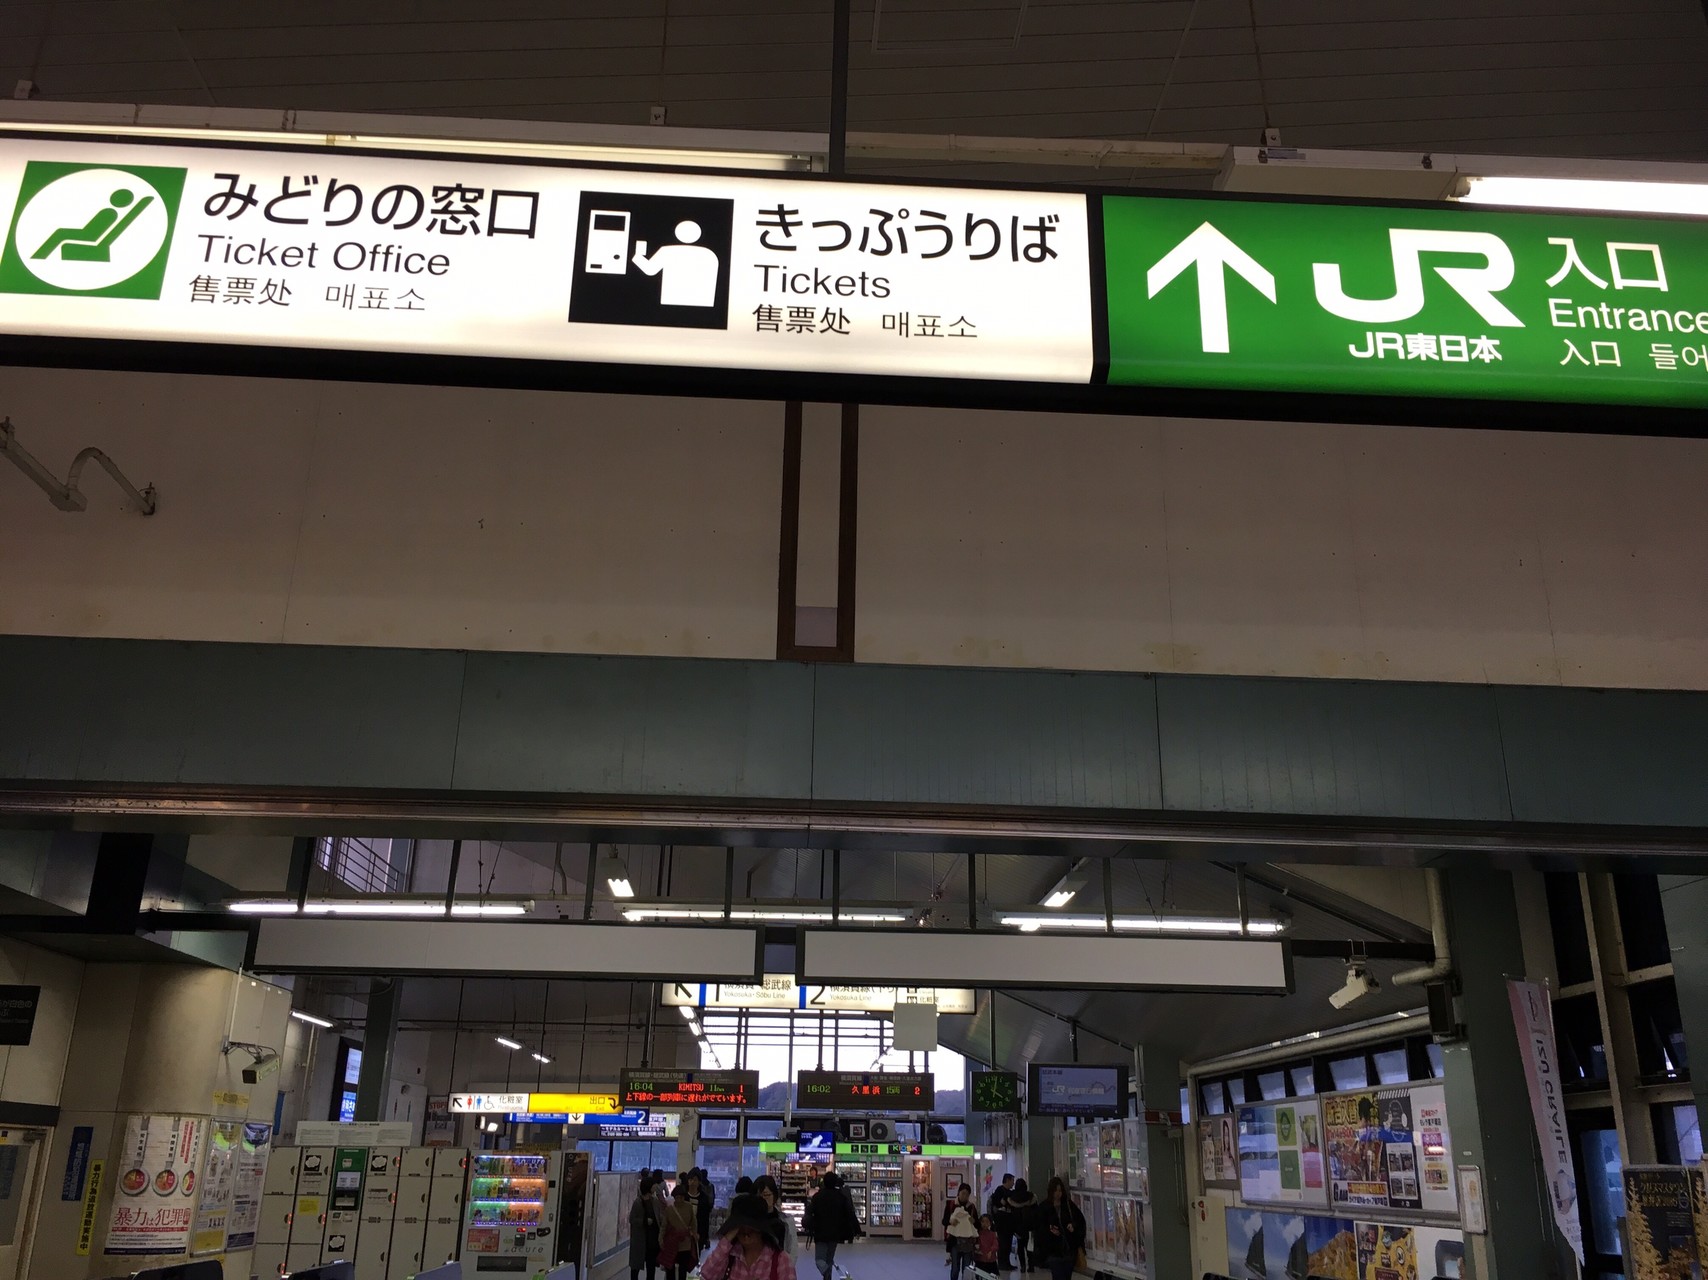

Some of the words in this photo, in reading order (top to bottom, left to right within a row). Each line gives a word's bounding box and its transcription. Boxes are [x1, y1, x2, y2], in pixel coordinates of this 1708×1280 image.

[203, 172, 540, 240] みどりの窓口
[755, 202, 1060, 264] きっぷうりば
[197, 233, 319, 269] Ticket
[332, 240, 451, 276] Office
[1544, 236, 1669, 292] 入口
[188, 274, 293, 308] 售票处
[753, 263, 892, 299] Tickets
[1312, 227, 1526, 328] JR
[325, 283, 427, 312] 매표소
[752, 303, 852, 336] 售票处
[881, 310, 979, 340] 매표소
[1548, 298, 1708, 334] Entrance
[1349, 331, 1503, 364] JR東日本
[1559, 339, 1622, 368] 入口
[589, 1096, 606, 1105] 出口
[629, 1082, 654, 1092] 16:04
[678, 1082, 705, 1092] KIMITSU
[806, 1084, 831, 1094] 16:02
[913, 1086, 921, 1096] 2
[637, 1110, 646, 1124] 2
[892, 1143, 919, 1152] KIOSK
